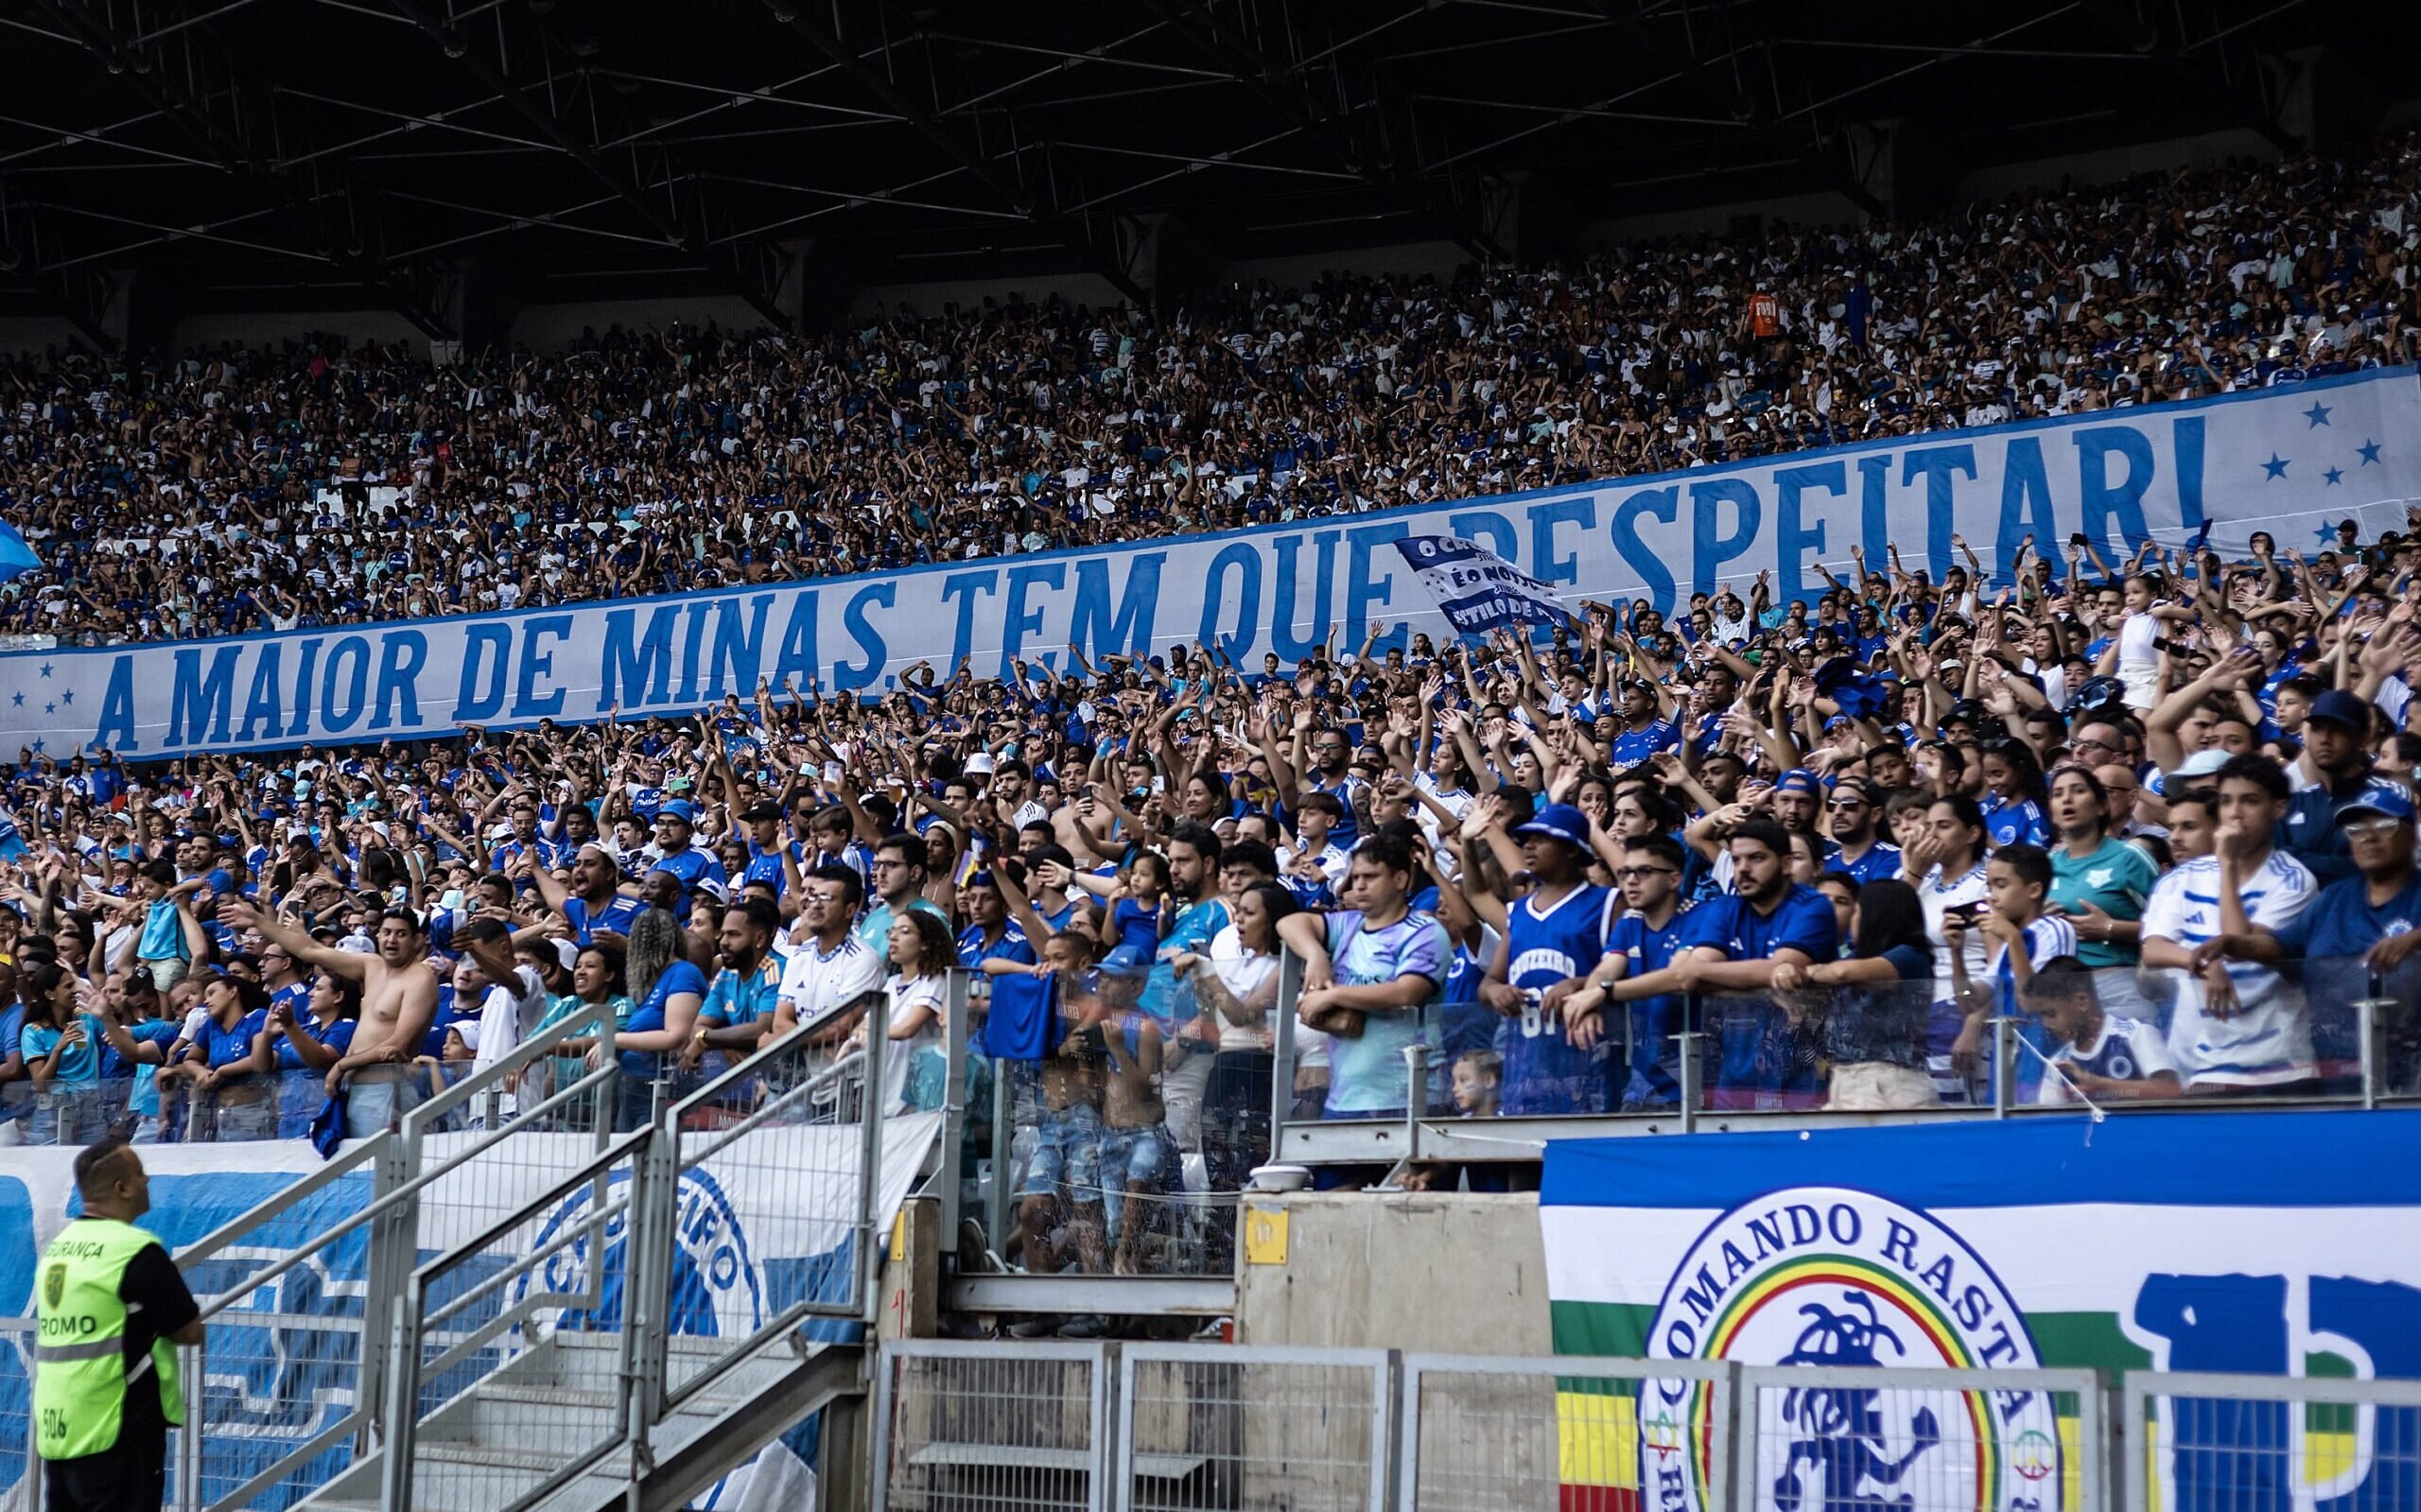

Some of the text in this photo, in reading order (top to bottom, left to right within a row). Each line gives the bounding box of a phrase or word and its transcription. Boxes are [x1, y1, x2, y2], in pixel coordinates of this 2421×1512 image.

[1419, 539, 1437, 558] O
[1451, 567, 1467, 588] É
[1467, 568, 1481, 582] O
[1507, 598, 1532, 617] DE
[87, 654, 139, 753] A
[163, 630, 428, 747] MAIOR
[452, 615, 573, 721] DE
[941, 550, 1167, 683] TEM
[1195, 520, 1411, 669] QUE
[1657, 1203, 1862, 1407] COMANDO
[1879, 1216, 2034, 1427] RASTA
[44, 1408, 67, 1439] 506
